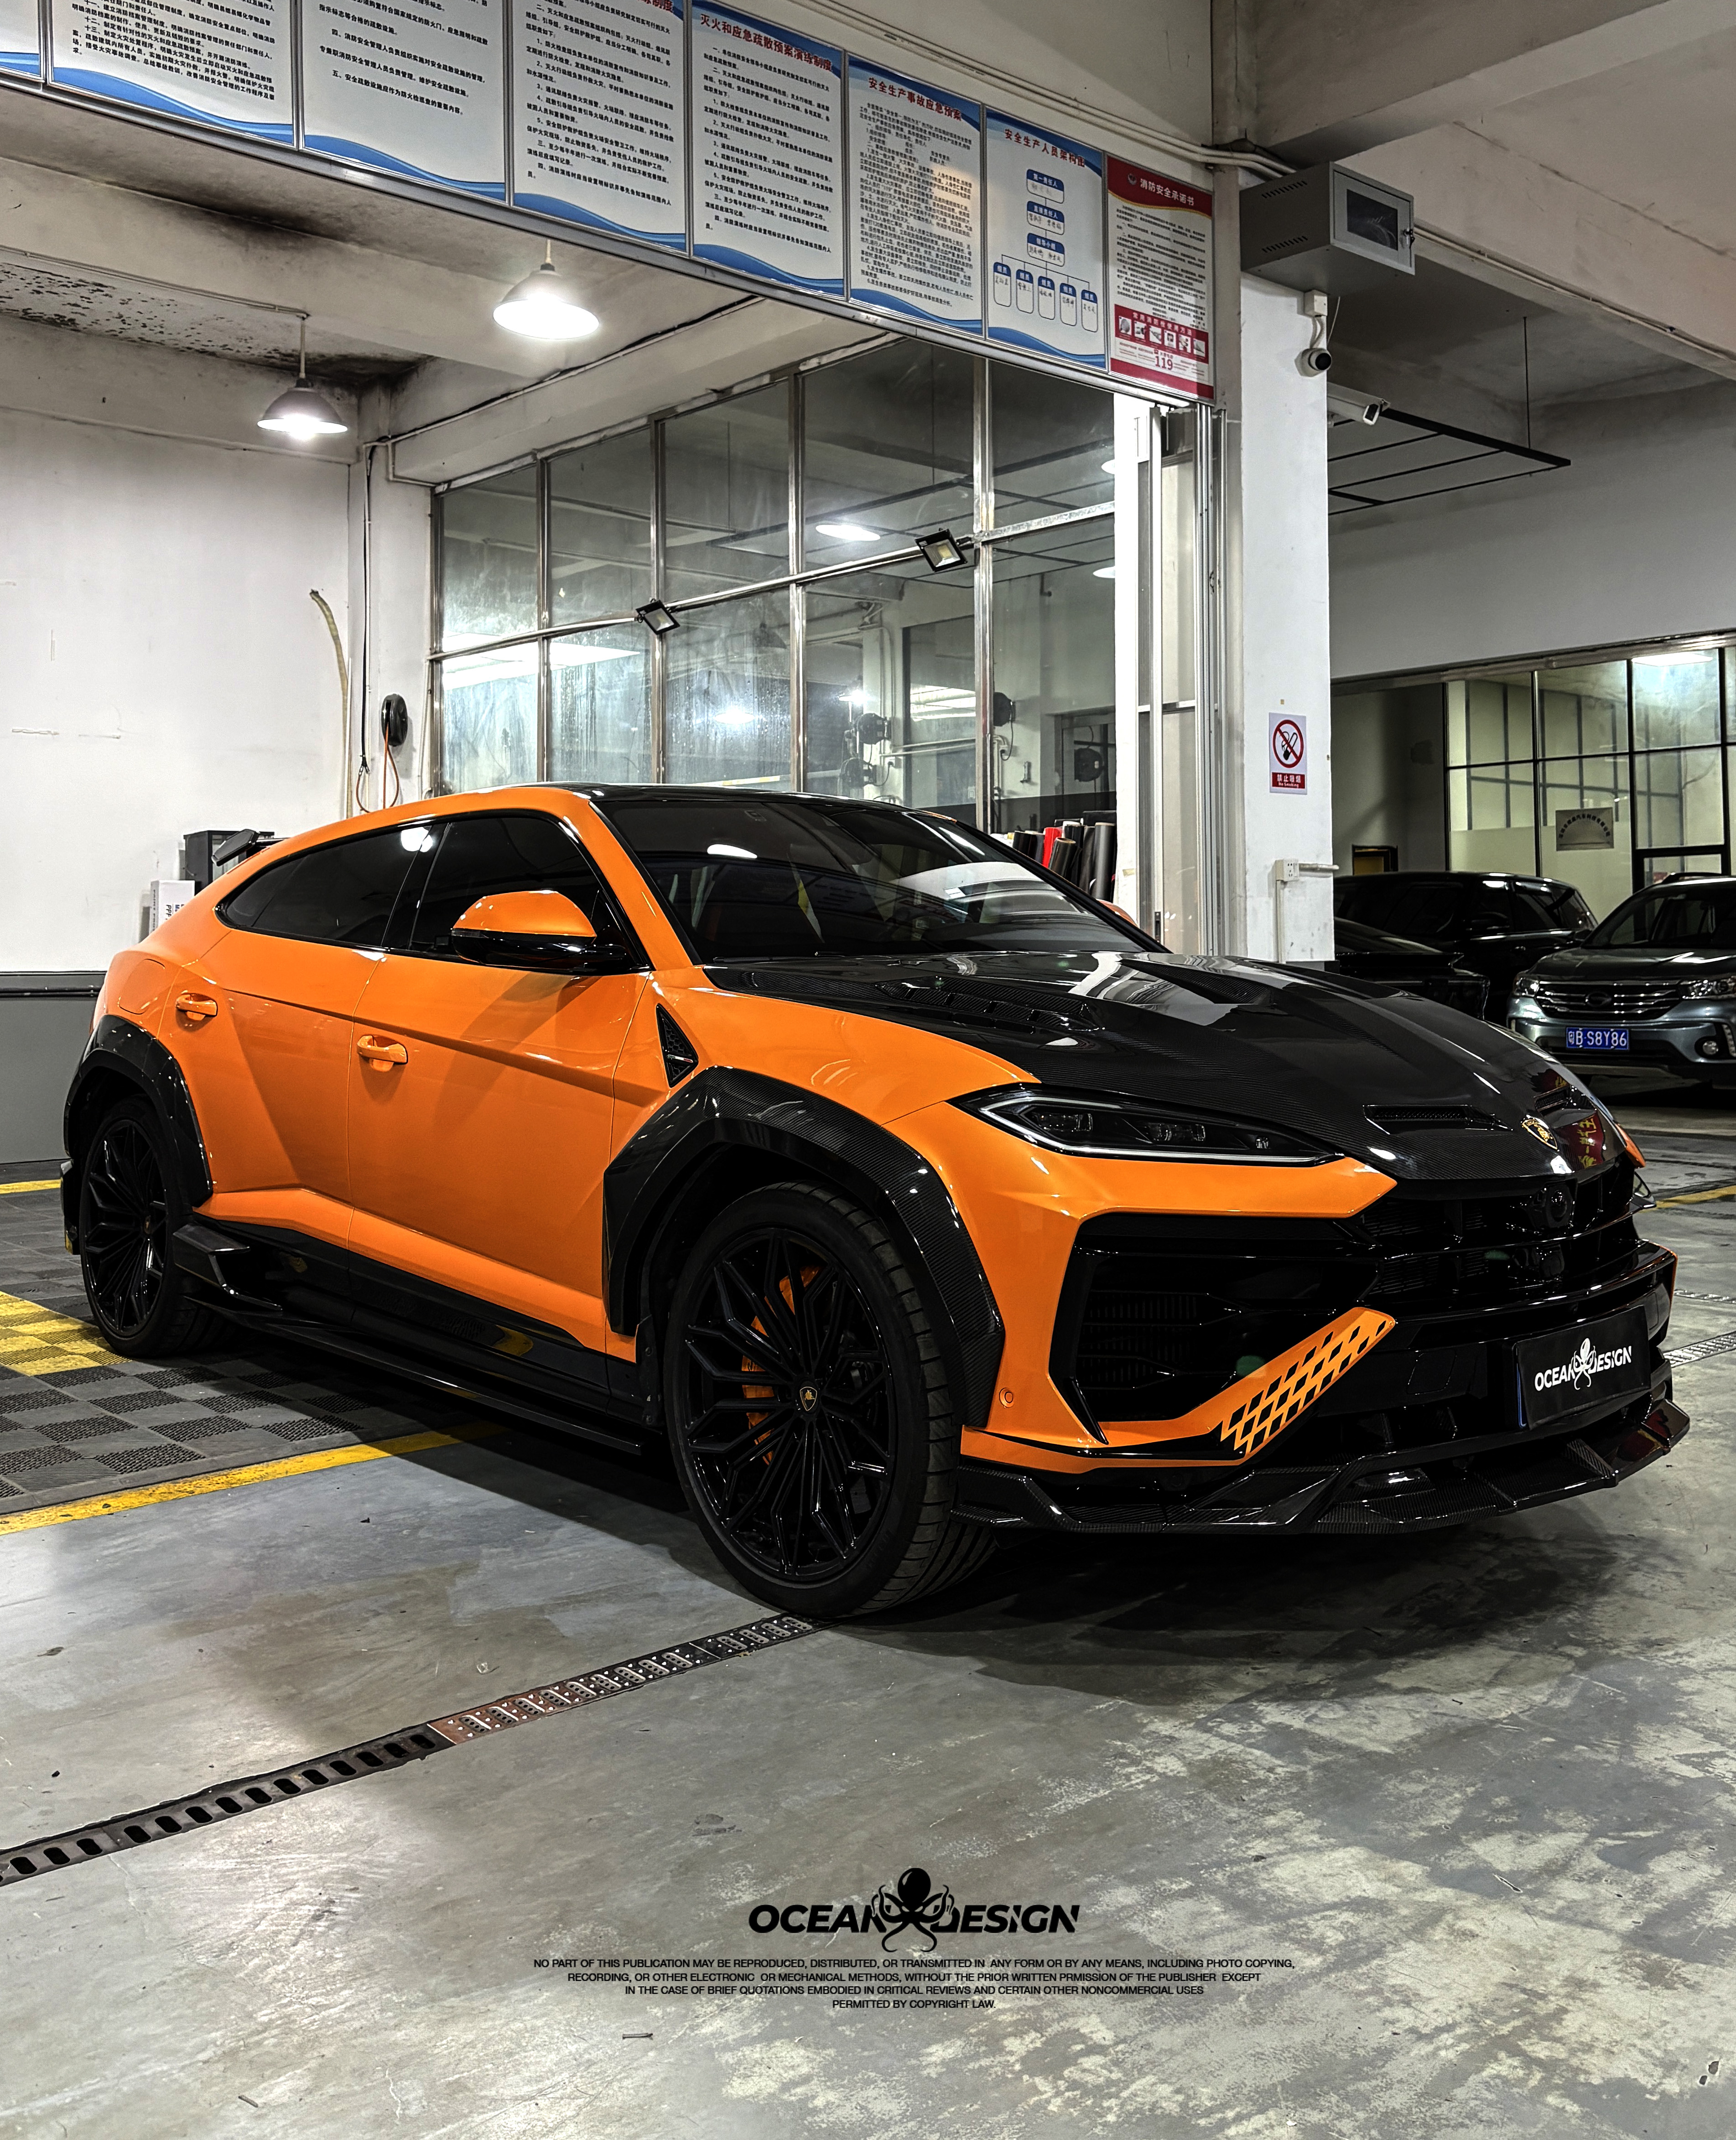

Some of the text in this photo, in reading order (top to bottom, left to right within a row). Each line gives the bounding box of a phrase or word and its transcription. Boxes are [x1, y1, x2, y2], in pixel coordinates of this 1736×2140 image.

[869, 77, 962, 121] 安全生产事故应急预案
[1005, 128, 1086, 167] 安全生产人员架构图
[1140, 178, 1195, 206] 消防安全承诺书
[1155, 356, 1173, 371] 119
